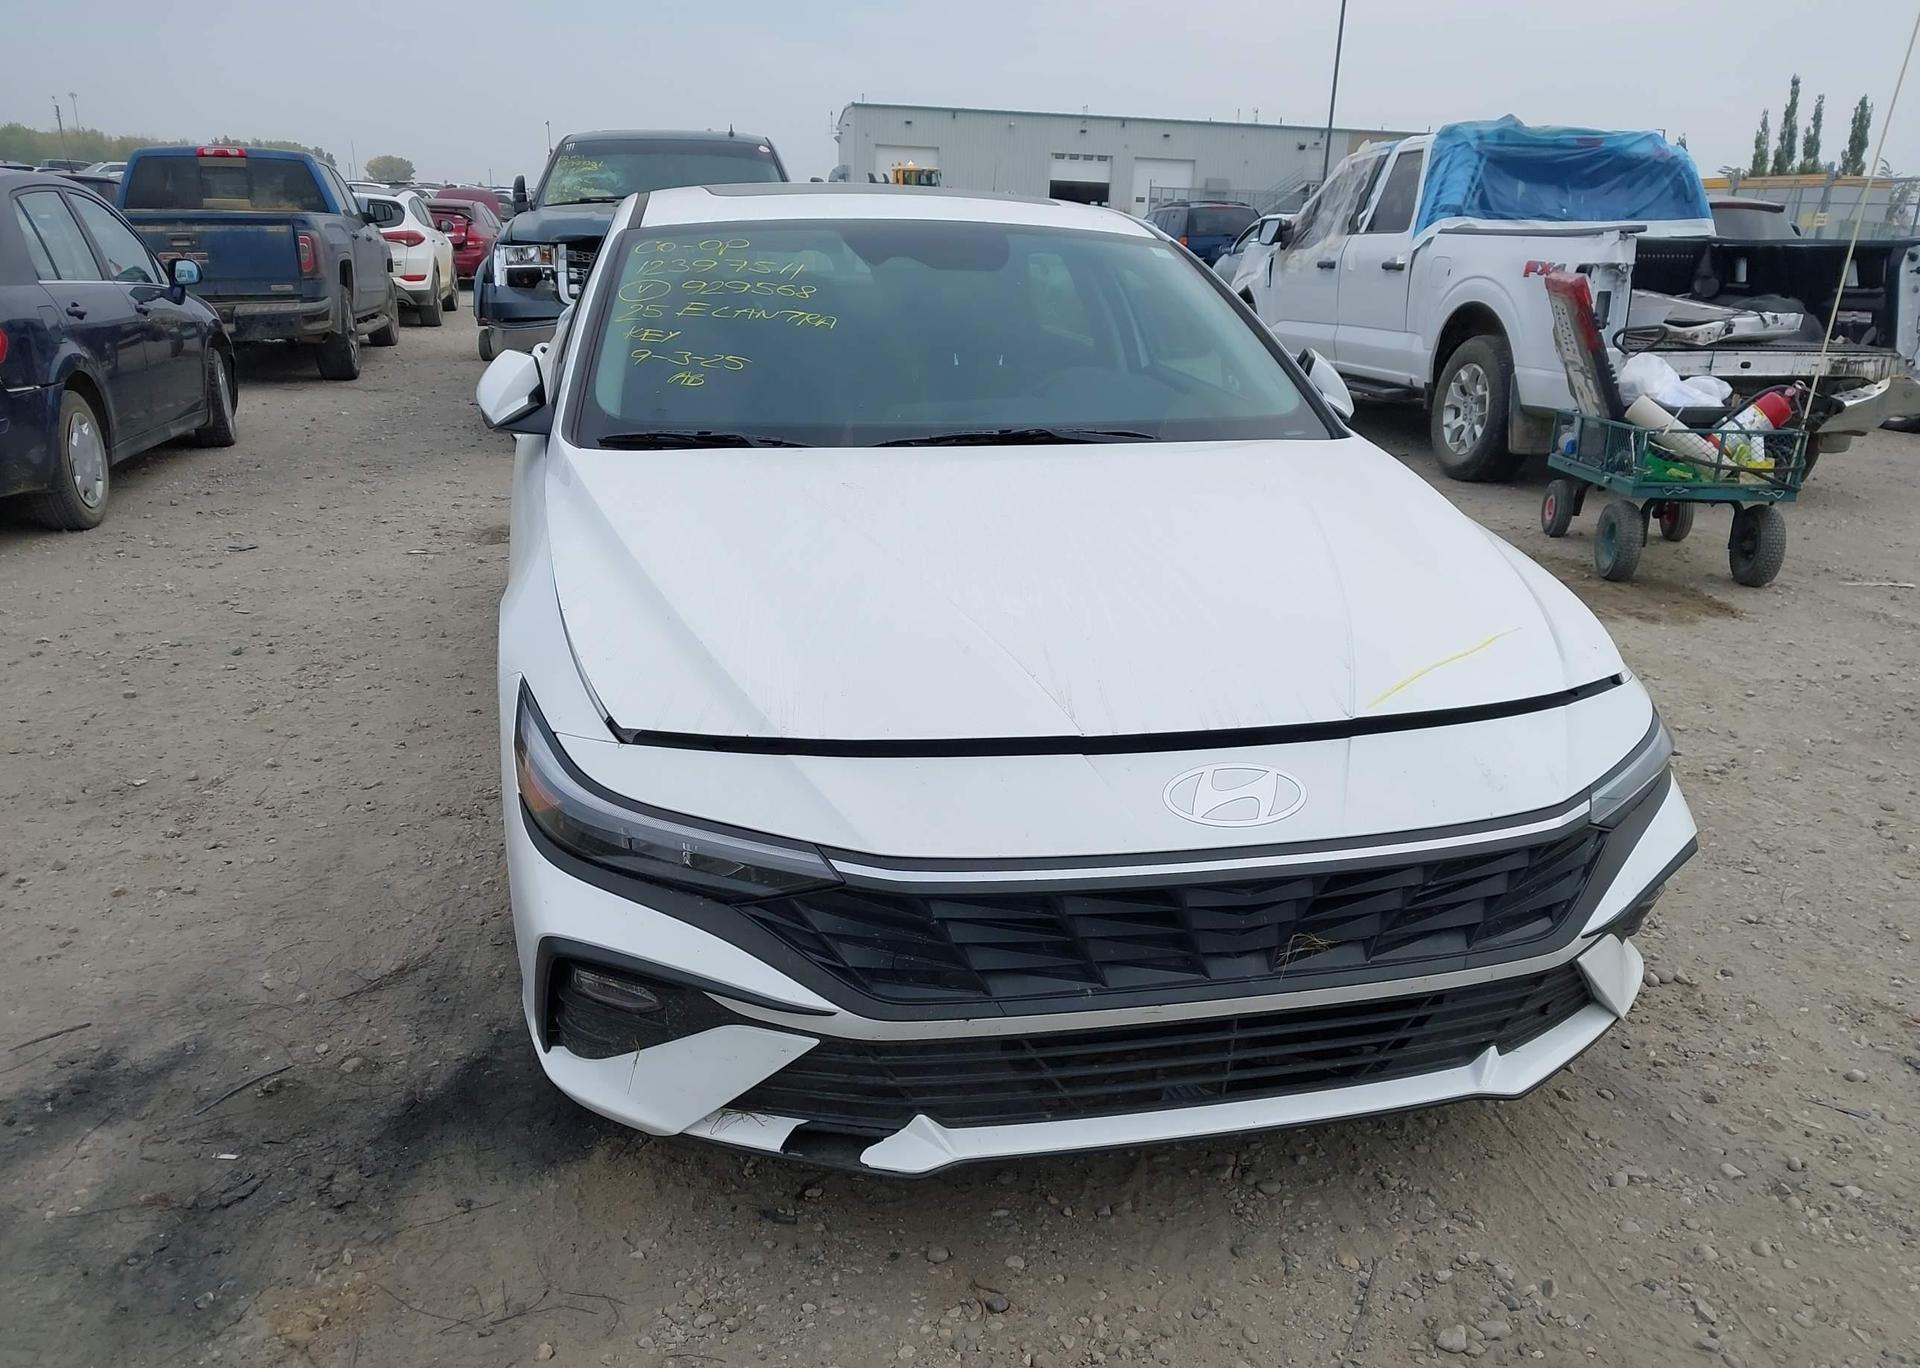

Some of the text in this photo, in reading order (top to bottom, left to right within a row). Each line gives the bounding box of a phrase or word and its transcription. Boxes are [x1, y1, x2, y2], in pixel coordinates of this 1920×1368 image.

[637, 259, 806, 281] 12397511
[681, 281, 817, 299] 929568
[615, 303, 671, 321] 25
[624, 325, 681, 344] KEY
[631, 348, 752, 371] 9-3-25
